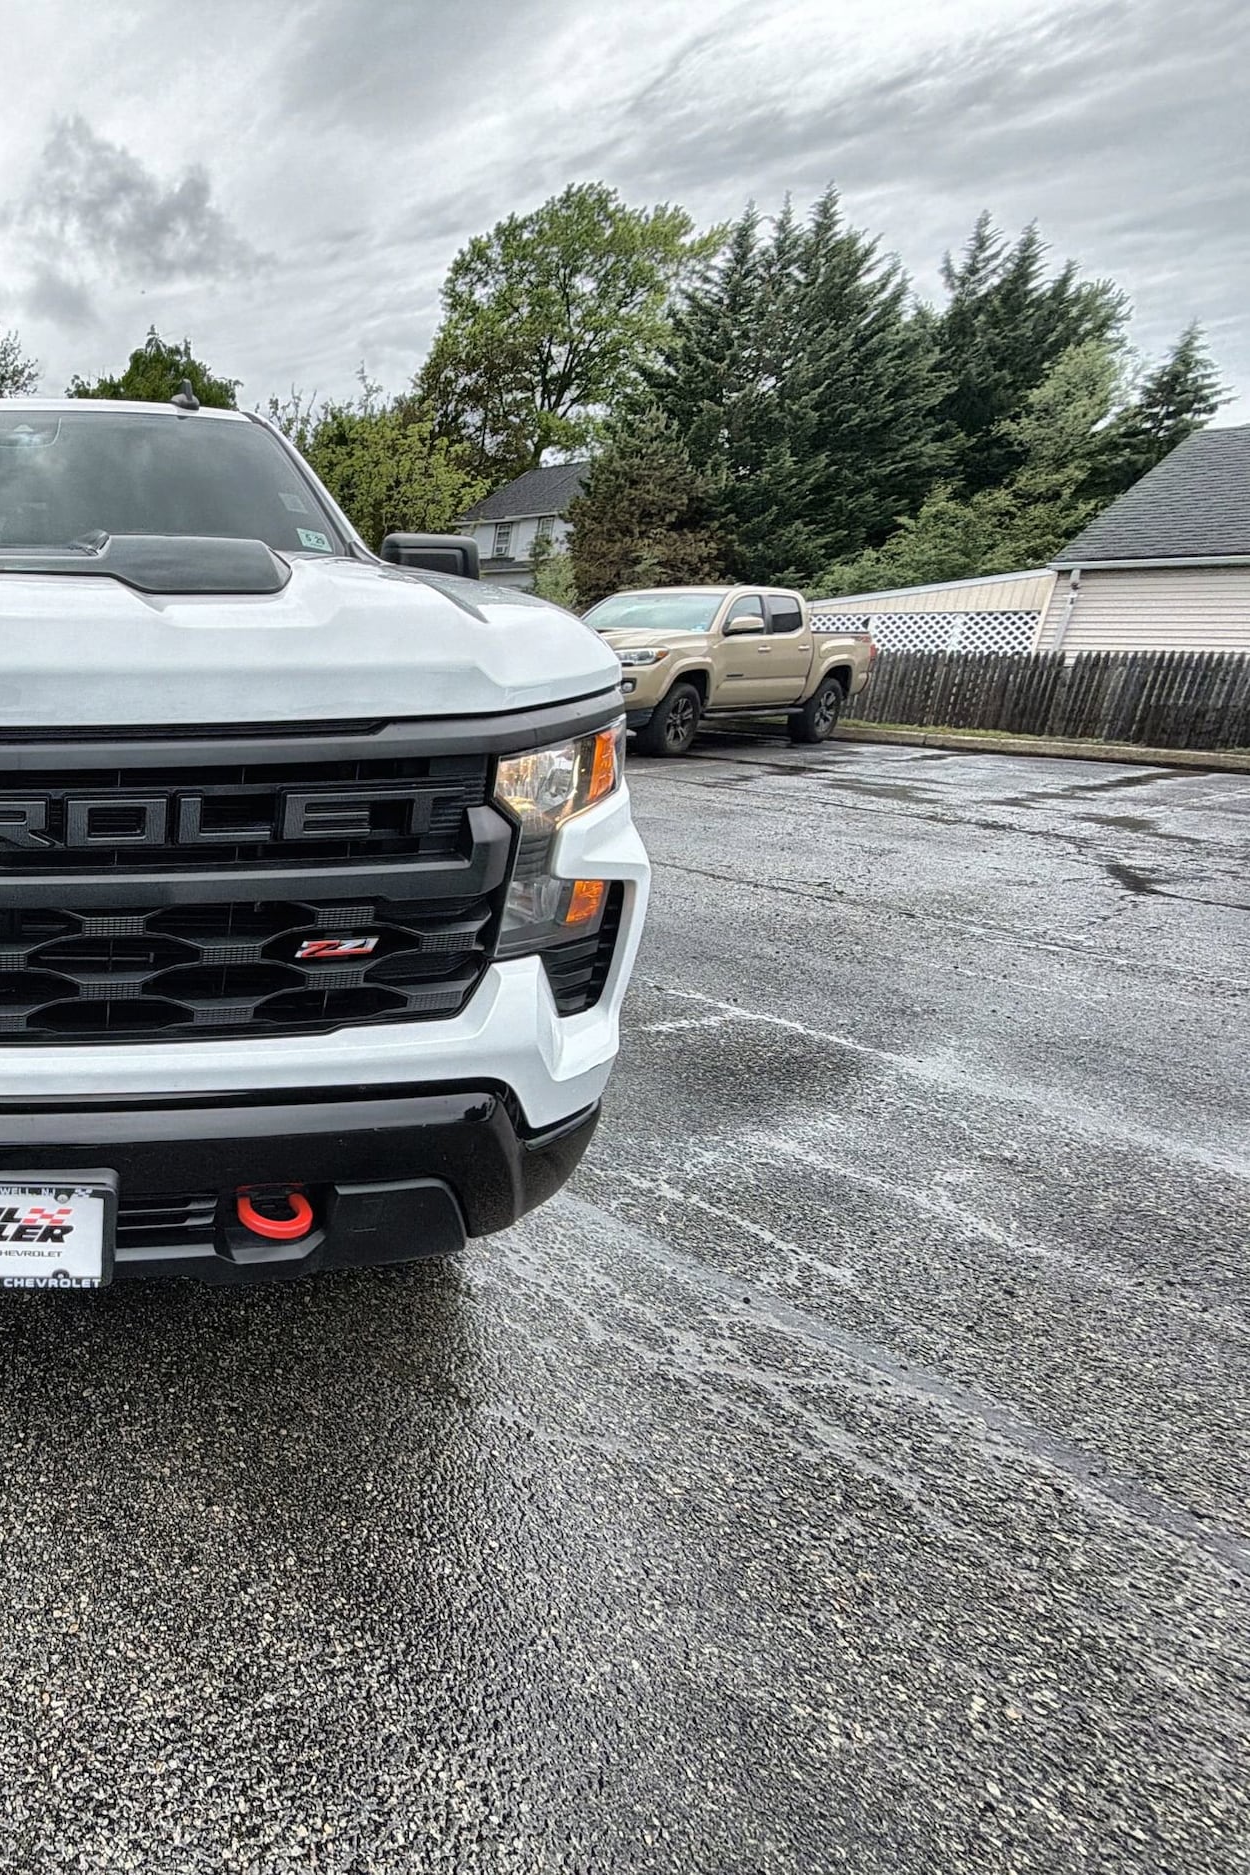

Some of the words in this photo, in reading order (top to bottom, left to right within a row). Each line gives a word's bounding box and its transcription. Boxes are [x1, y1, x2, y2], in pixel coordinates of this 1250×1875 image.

[294, 937, 380, 958] Z71
[41, 1188, 56, 1198] NJ
[3, 1278, 102, 1289] CHEVROLET
